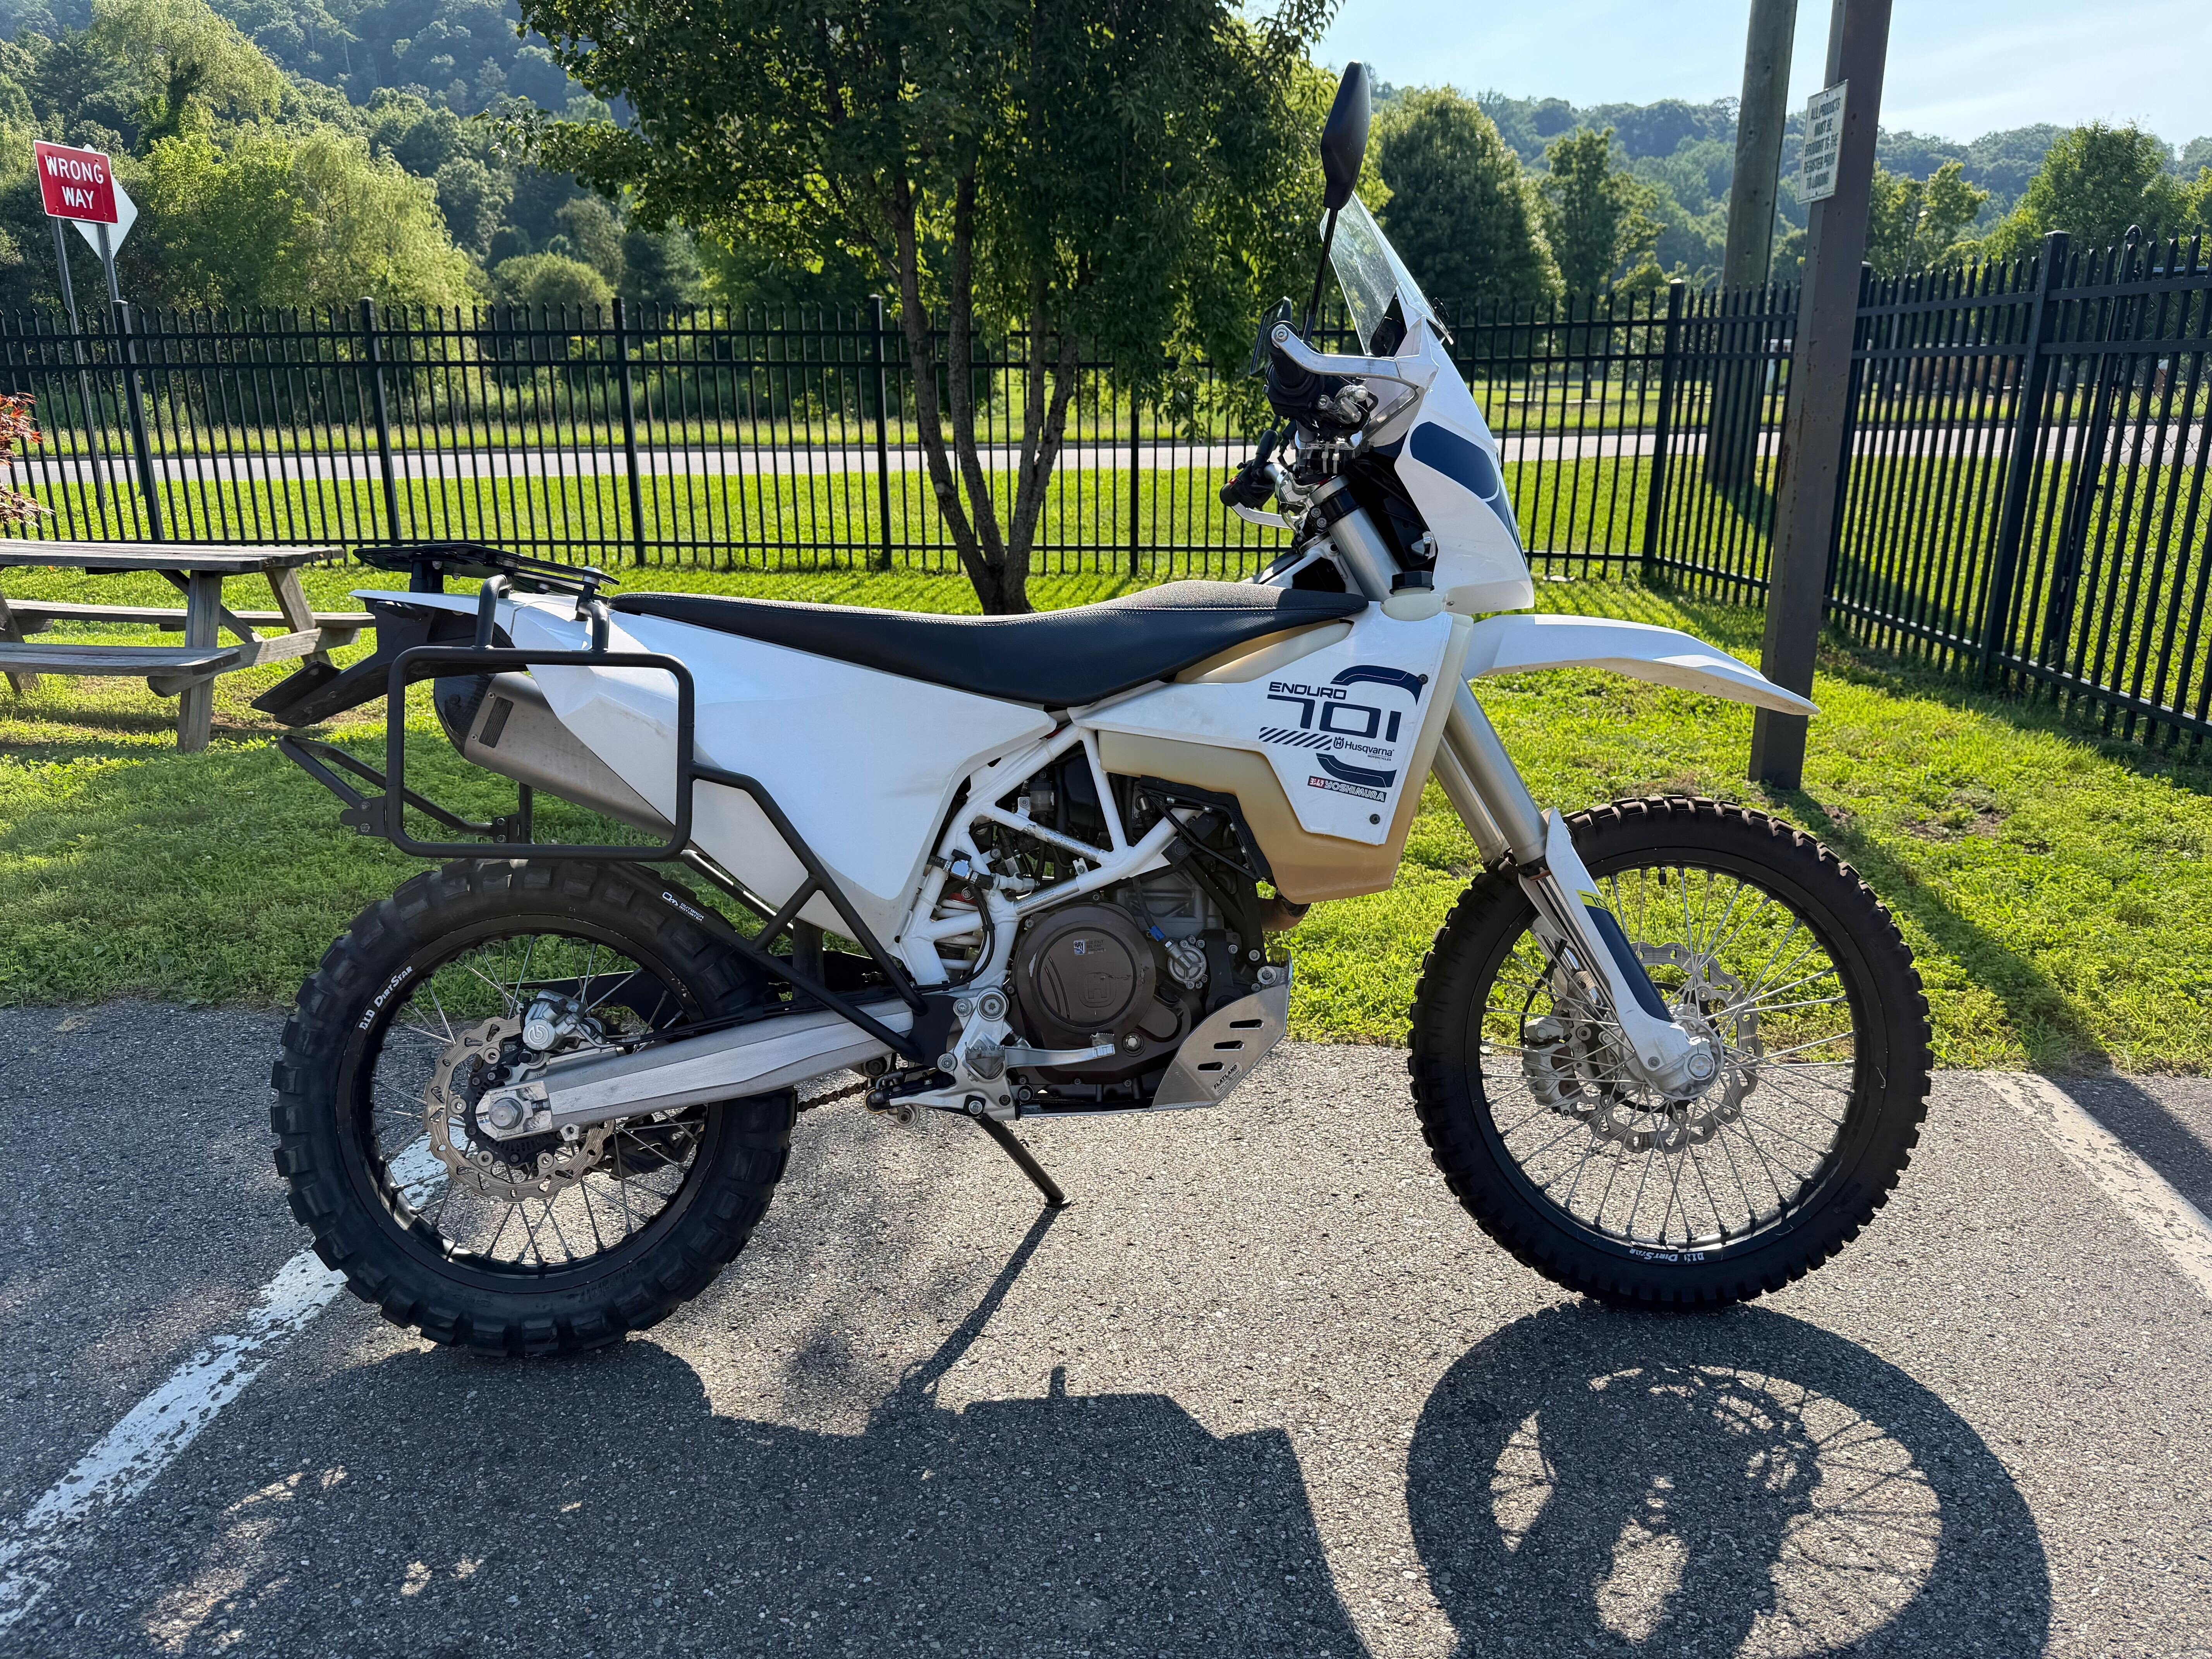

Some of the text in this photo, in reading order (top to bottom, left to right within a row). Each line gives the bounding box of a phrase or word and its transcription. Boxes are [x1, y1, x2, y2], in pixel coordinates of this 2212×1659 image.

[1820, 97, 1841, 117] PRODUCTS
[45, 155, 104, 184] WRONG
[62, 186, 94, 209] WAY
[1269, 682, 1347, 700] ENDURO
[1267, 694, 1402, 743] 701
[1345, 740, 1393, 757] Husqvarna
[1324, 780, 1384, 801] YOSHIMURA
[1074, 941, 1084, 952] RAY
[1214, 1064, 1237, 1089] FLATLAND
